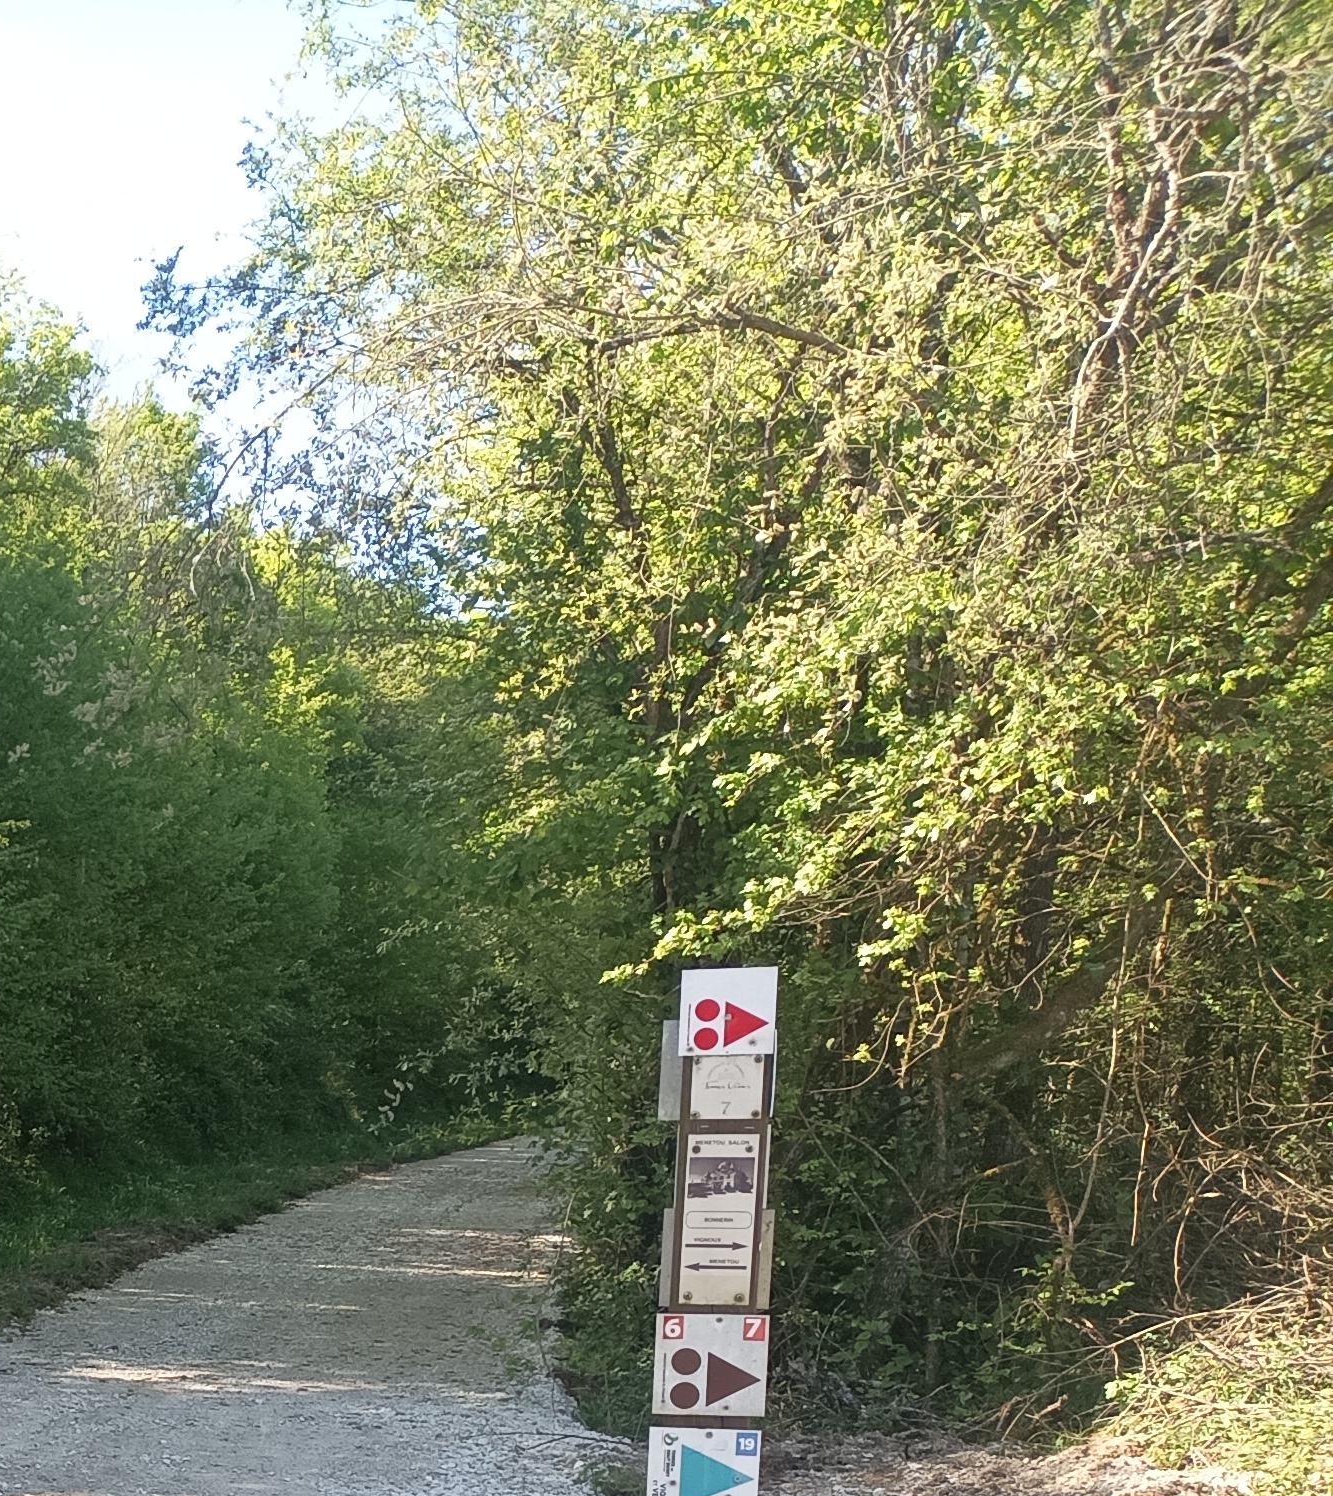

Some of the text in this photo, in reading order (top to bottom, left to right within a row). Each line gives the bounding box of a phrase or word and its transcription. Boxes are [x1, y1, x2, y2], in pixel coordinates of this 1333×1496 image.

[721, 1101, 731, 1115] 7
[664, 1318, 681, 1338] 6
[744, 1319, 763, 1339] 7
[739, 1438, 755, 1451] 19
